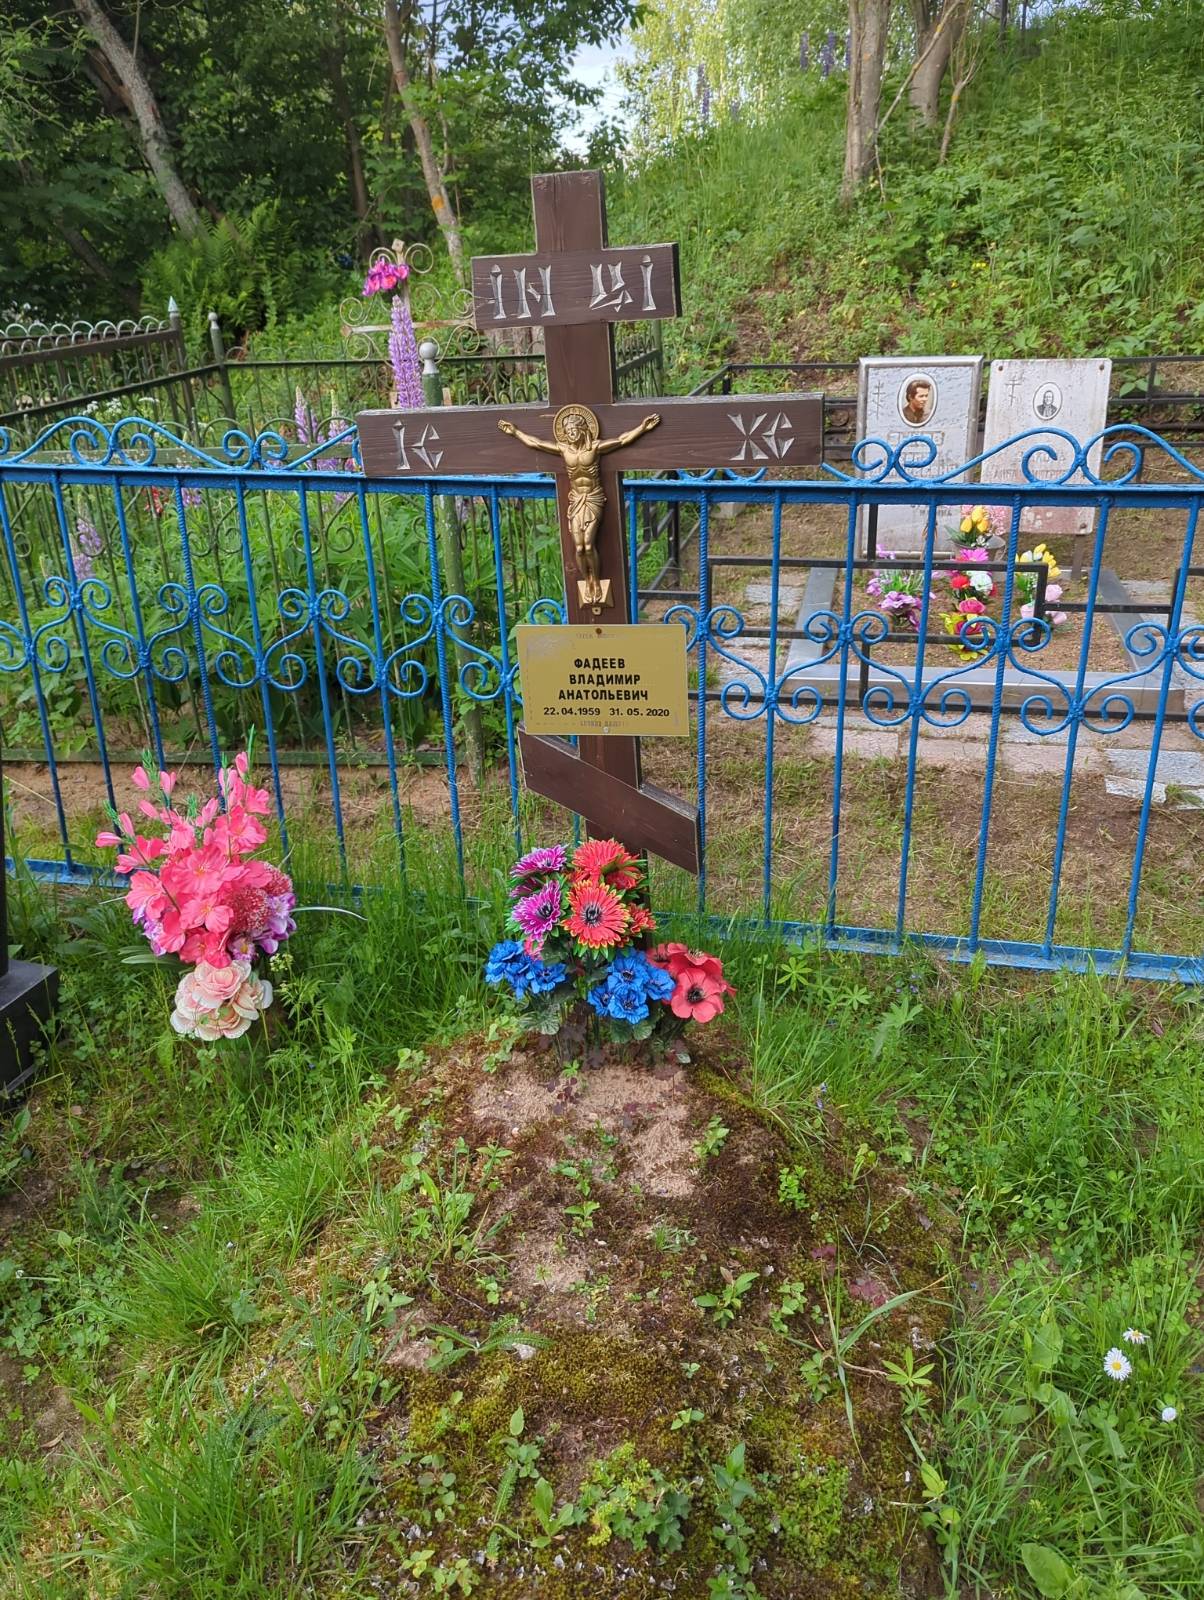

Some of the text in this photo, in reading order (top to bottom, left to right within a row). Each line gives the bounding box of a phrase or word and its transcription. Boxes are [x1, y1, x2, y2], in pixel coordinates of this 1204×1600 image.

[574, 658, 625, 671] ФАДЕЕВ
[569, 674, 640, 687] ВЛАДИМИР
[558, 690, 648, 701] АНАТОЛЬЕВИЧ
[543, 707, 601, 716] 22.04.1959
